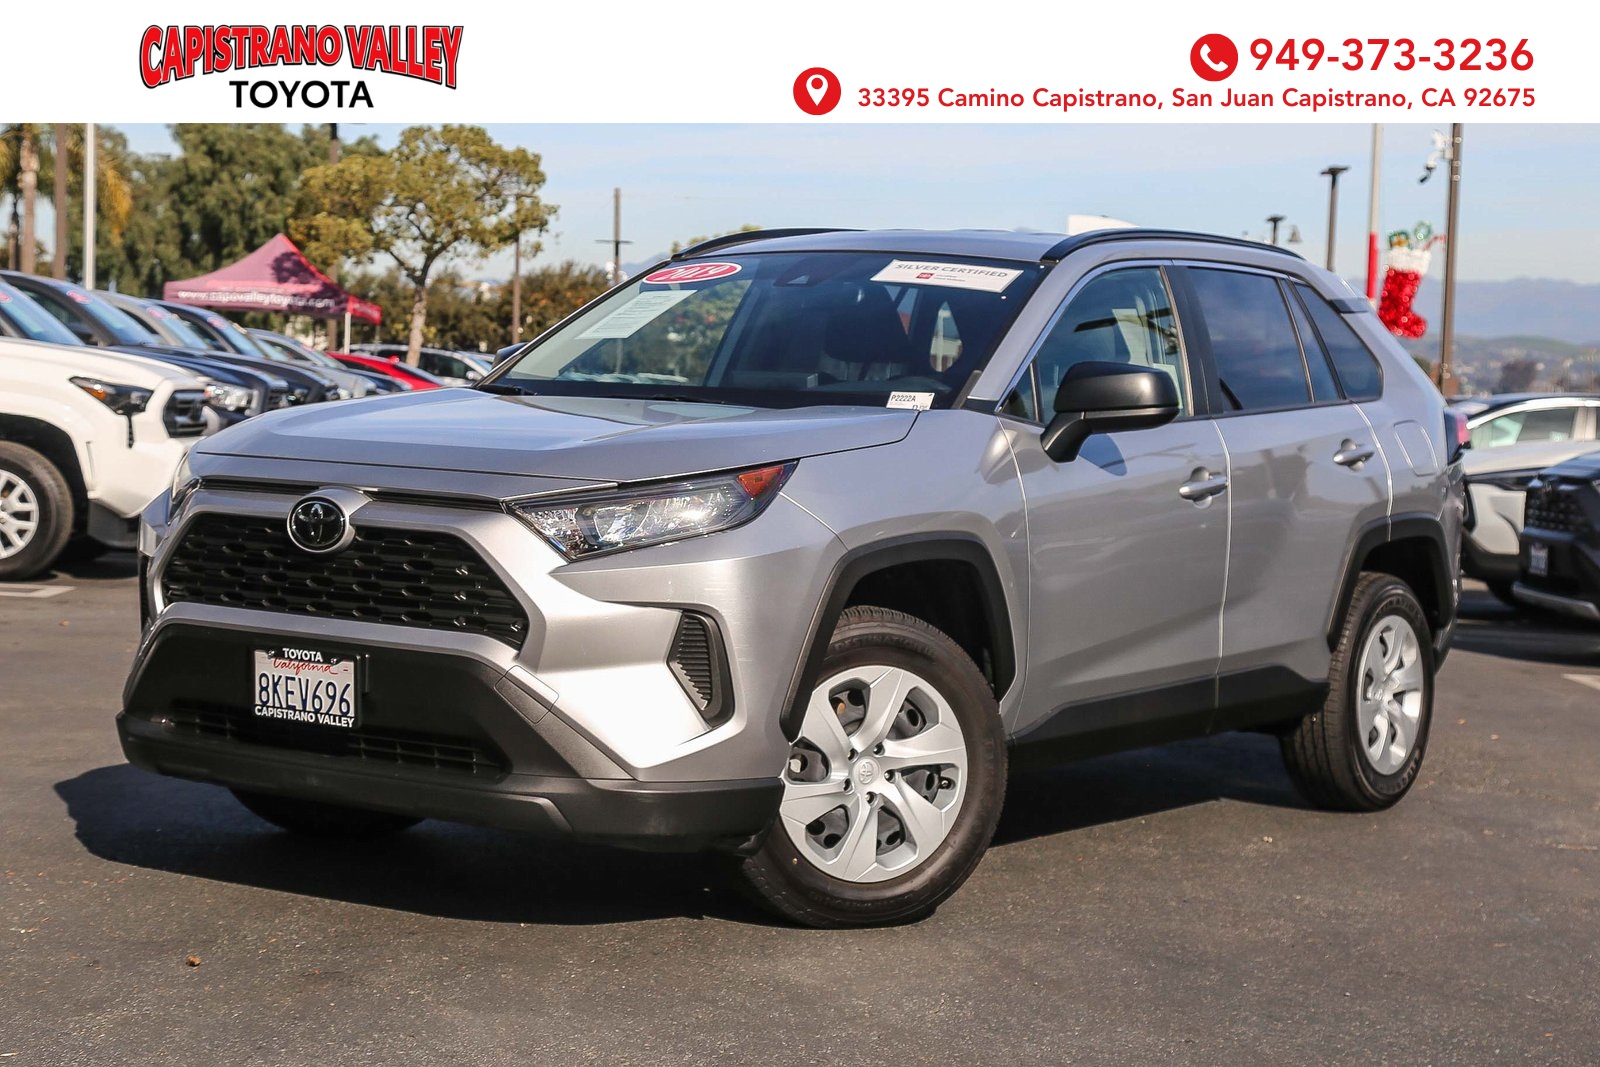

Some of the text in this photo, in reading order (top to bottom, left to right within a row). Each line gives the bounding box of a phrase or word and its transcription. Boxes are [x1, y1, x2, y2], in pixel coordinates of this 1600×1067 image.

[895, 262, 940, 272] SILVER
[941, 266, 1008, 278] CERTIFIED
[282, 648, 323, 662] TOYOTA
[273, 658, 338, 675] California
[258, 672, 351, 716] 8KEV696
[255, 706, 354, 728] CAPISTRANO VALLEY
